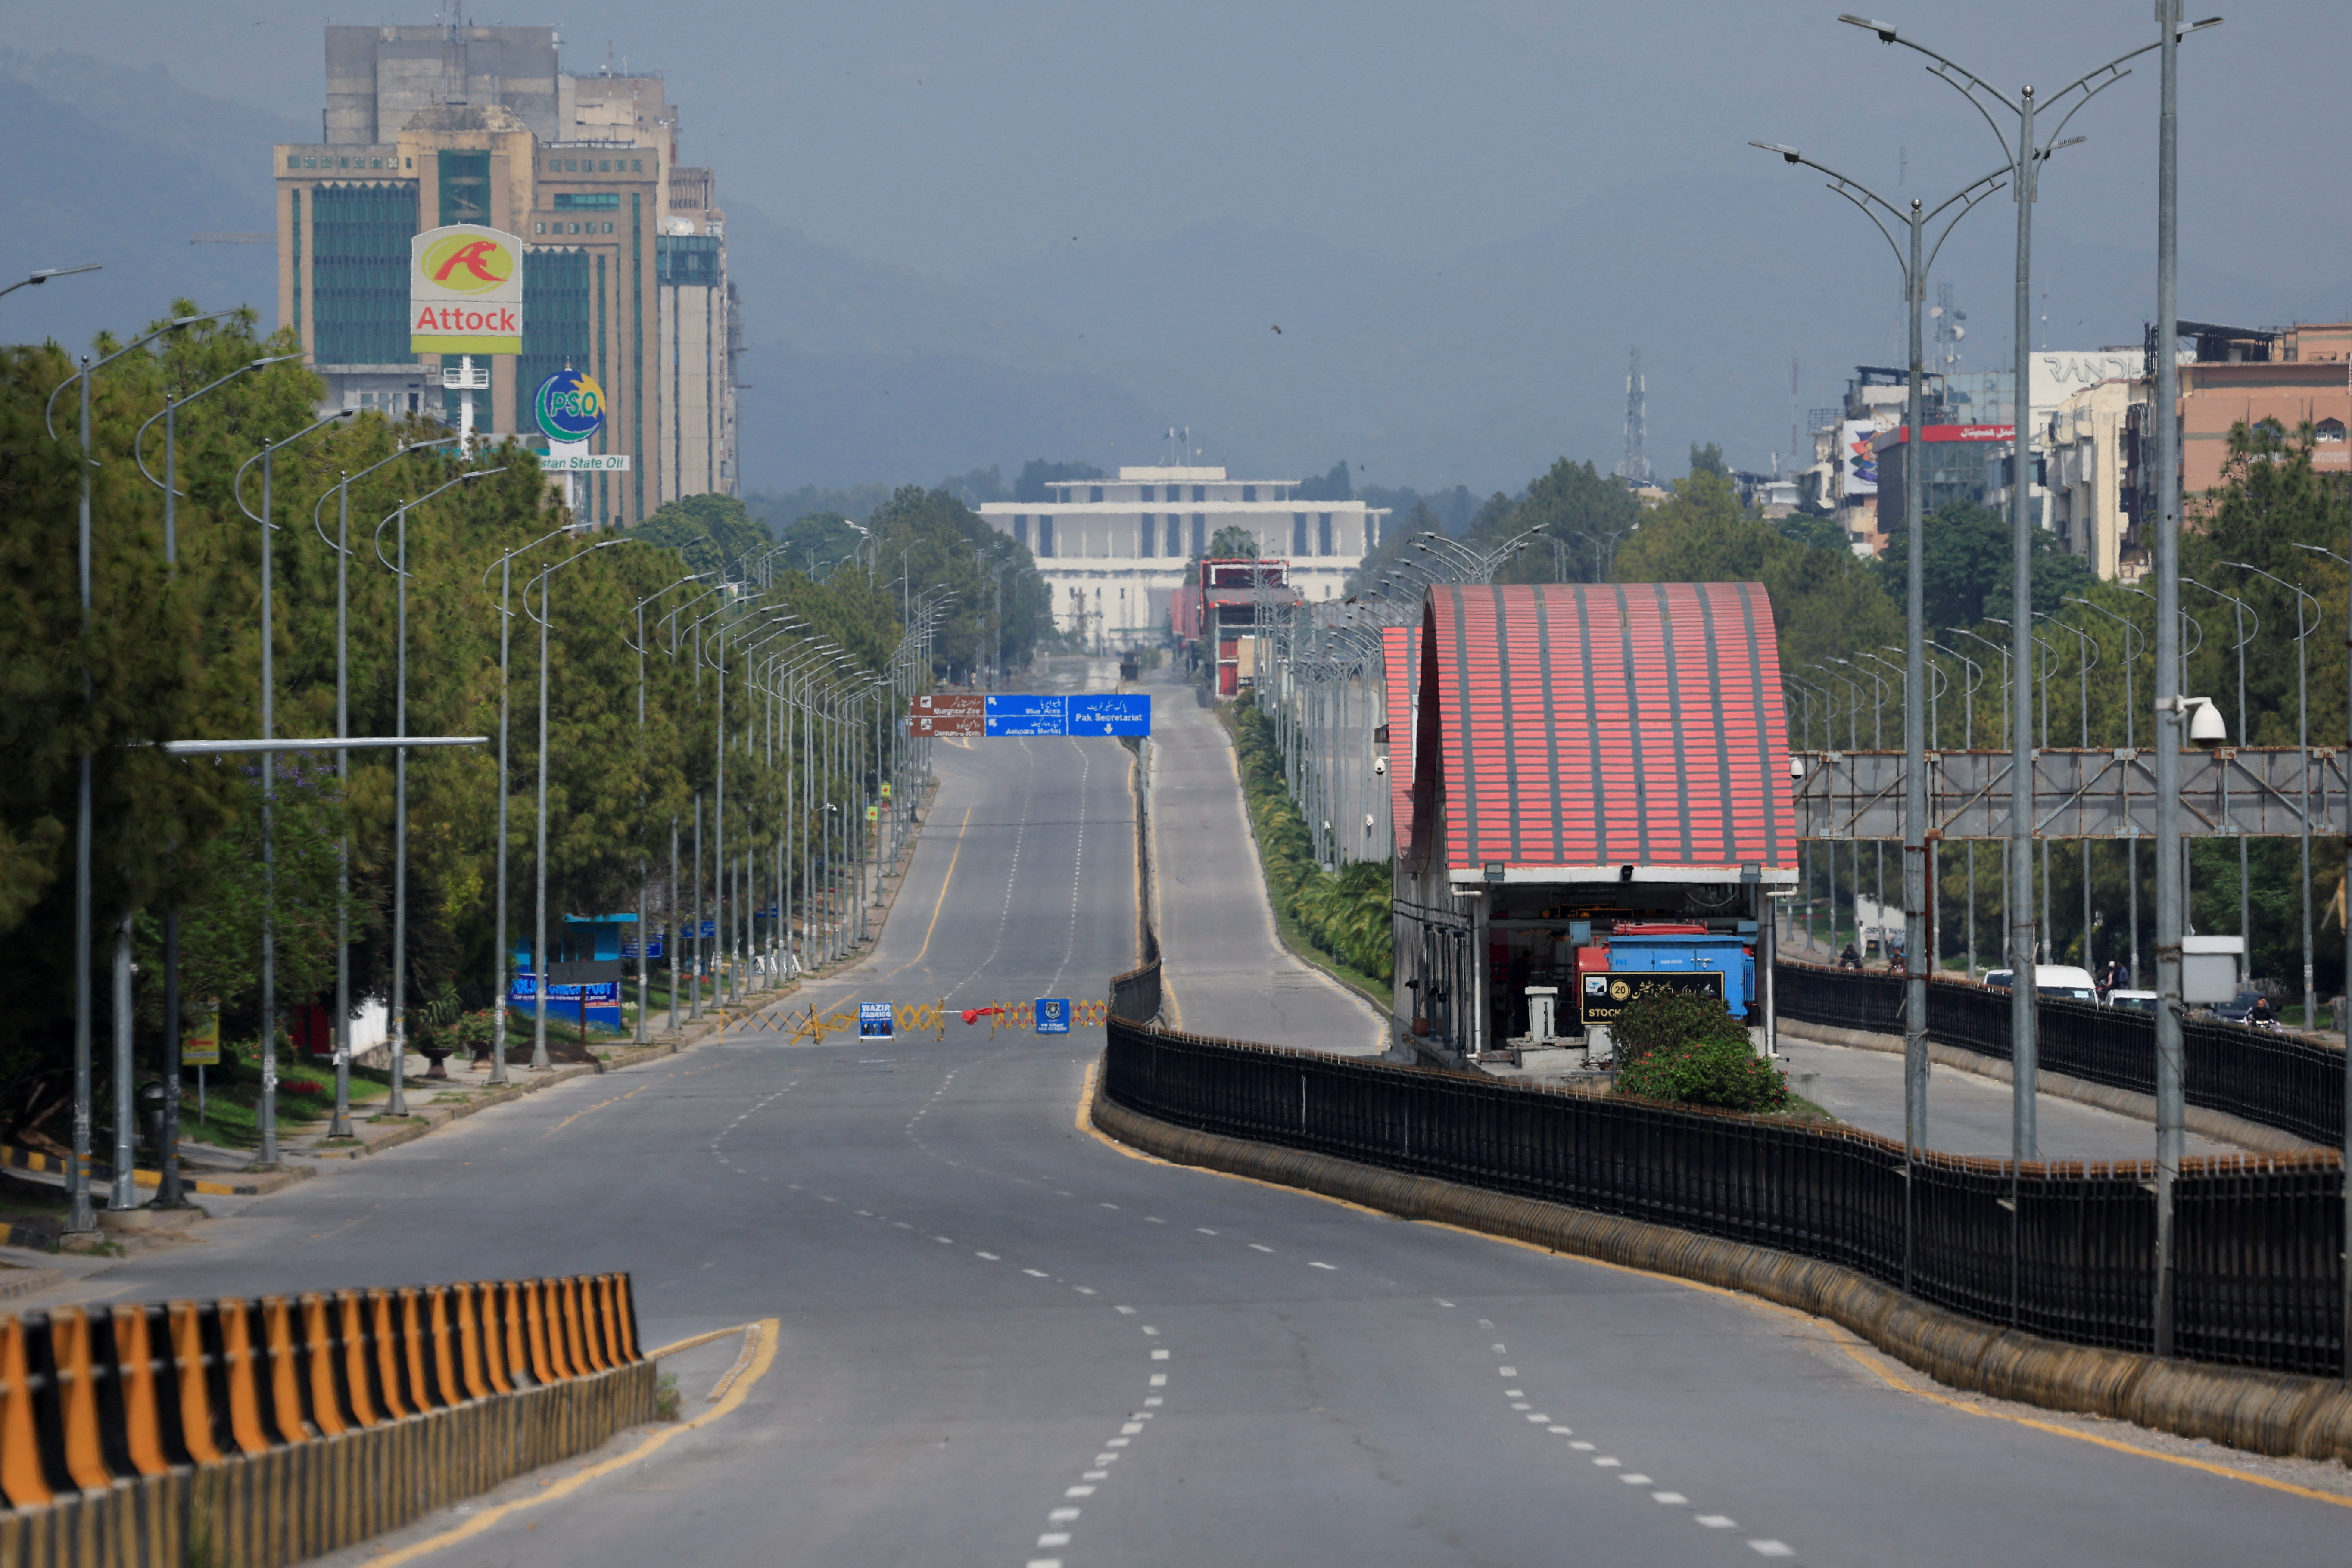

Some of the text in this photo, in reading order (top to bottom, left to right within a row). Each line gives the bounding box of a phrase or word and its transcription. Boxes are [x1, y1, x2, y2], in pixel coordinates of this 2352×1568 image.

[416, 306, 515, 331] Attock
[550, 391, 598, 417] PSO
[541, 457, 623, 469] stan State Oil
[1075, 713, 1143, 722] Pak Secretariat
[1589, 1008, 1621, 1017] STOCK
